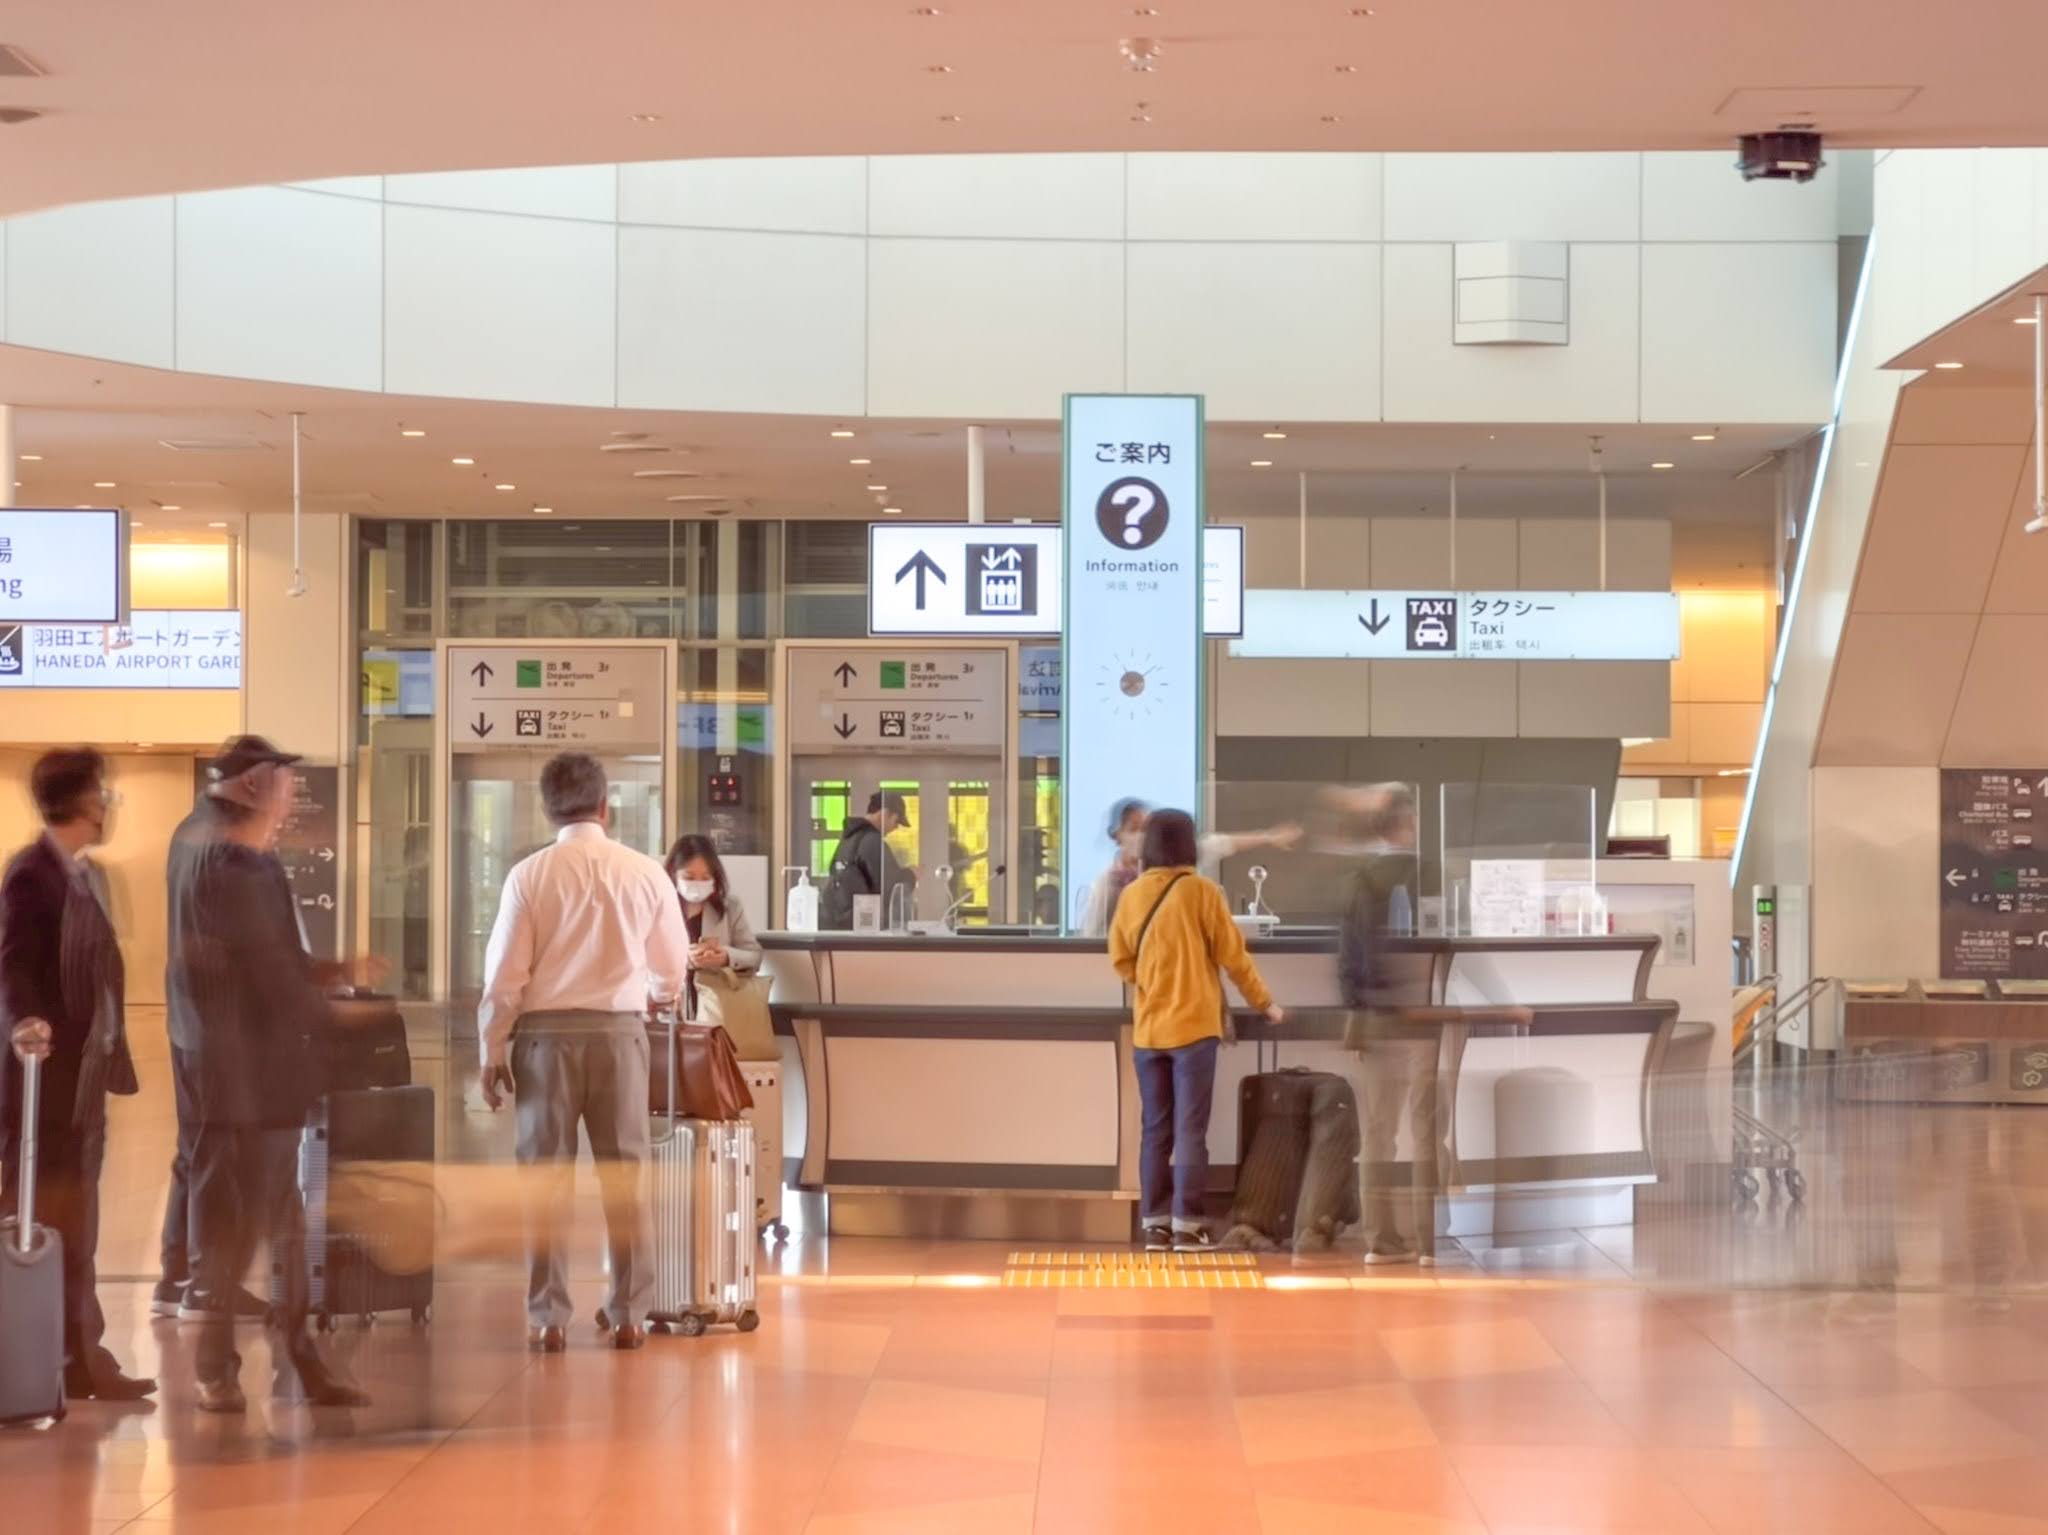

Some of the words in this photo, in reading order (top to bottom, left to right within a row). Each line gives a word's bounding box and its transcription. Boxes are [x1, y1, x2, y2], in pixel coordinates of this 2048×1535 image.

[1094, 441, 1171, 465] ご案内
[1086, 558, 1179, 572] Information
[1408, 601, 1453, 615] TAXI
[1471, 599, 1556, 616] タクシー
[1470, 621, 1505, 635] Taxi
[36, 654, 106, 669] HANEDA
[116, 654, 193, 669] AIRPORT
[548, 710, 594, 720] タクシー
[911, 711, 959, 721] タクシー
